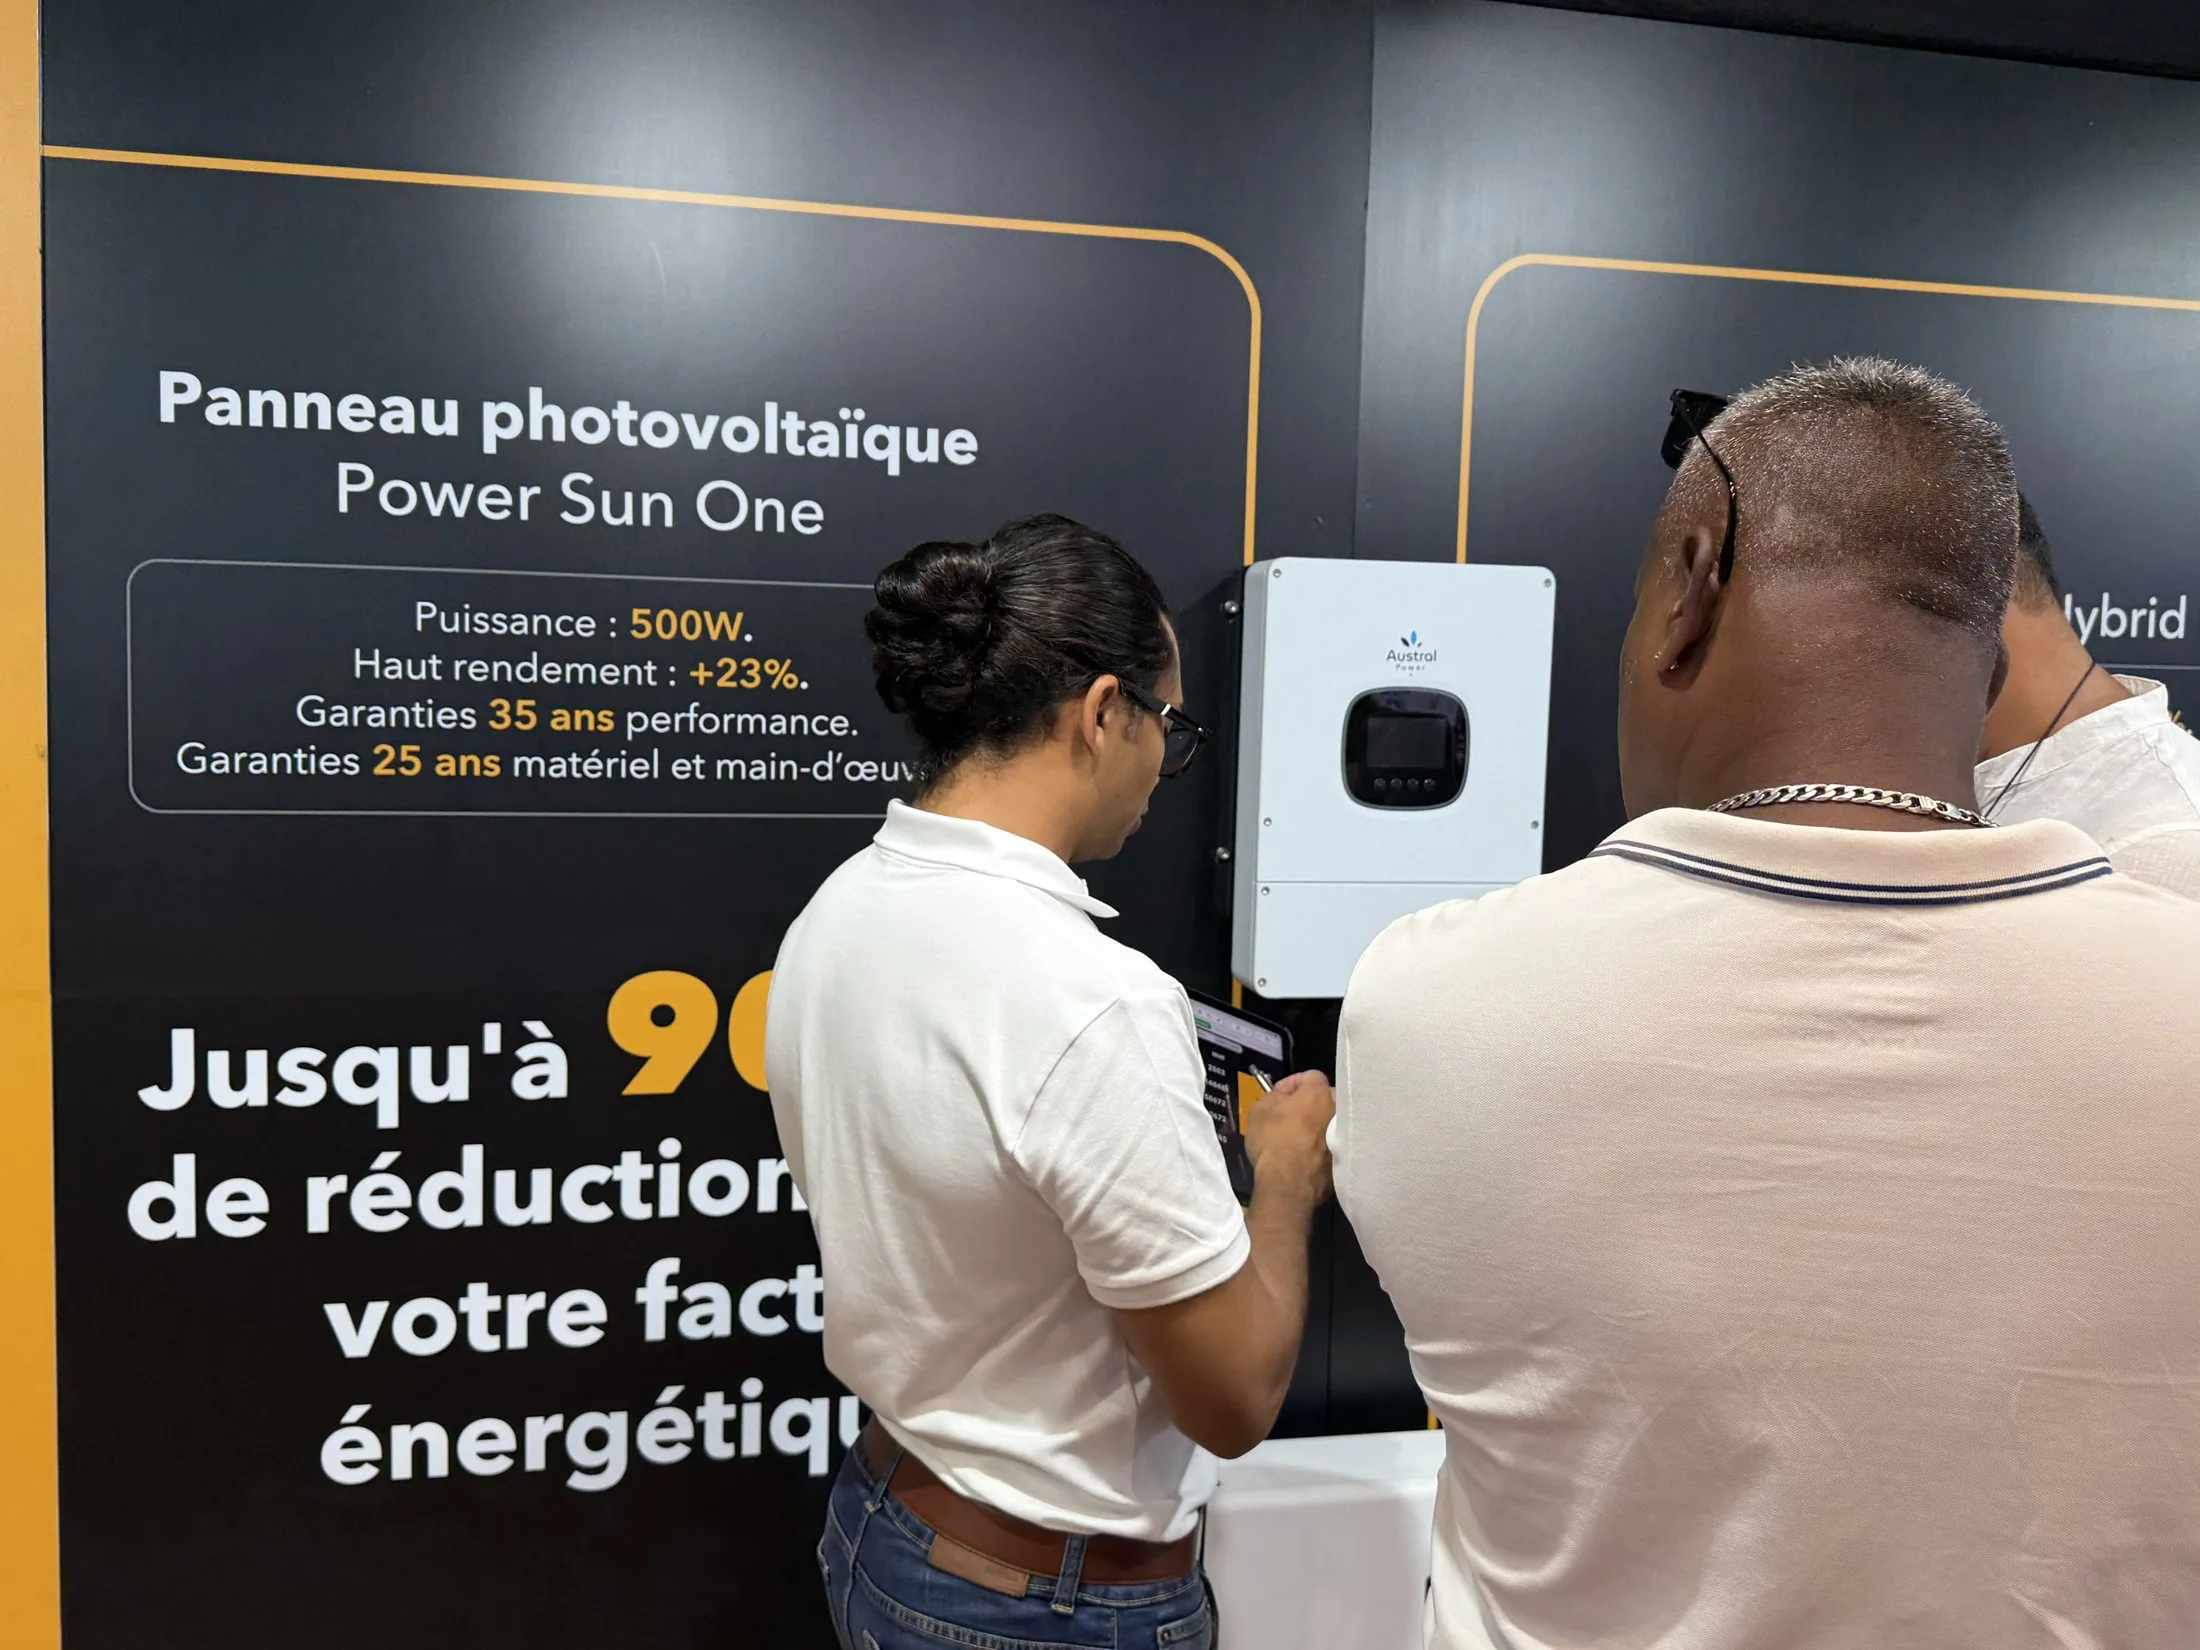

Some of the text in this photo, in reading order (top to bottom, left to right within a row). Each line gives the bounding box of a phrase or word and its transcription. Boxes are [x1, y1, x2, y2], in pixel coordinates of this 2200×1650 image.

[159, 370, 978, 477] Panneau photovoltaïque
[338, 462, 824, 535] Power Sun One
[416, 601, 596, 638] Puissance
[630, 607, 753, 643] 500W.
[1386, 648, 1437, 662] Austral
[354, 647, 443, 681] Haut
[454, 654, 657, 687] rendement
[689, 657, 809, 690] +23%.
[296, 694, 858, 741] Garanties 35 ans performance.
[176, 741, 360, 776] Garanties
[373, 743, 422, 776] 25
[435, 754, 501, 777] ans
[513, 747, 659, 780] matériel
[671, 754, 706, 781] et
[138, 1020, 568, 1129] Jusqu'à
[127, 1137, 809, 1241] de réduction
[323, 1257, 824, 1358] votre fact
[320, 1377, 861, 1491] énergétiq
